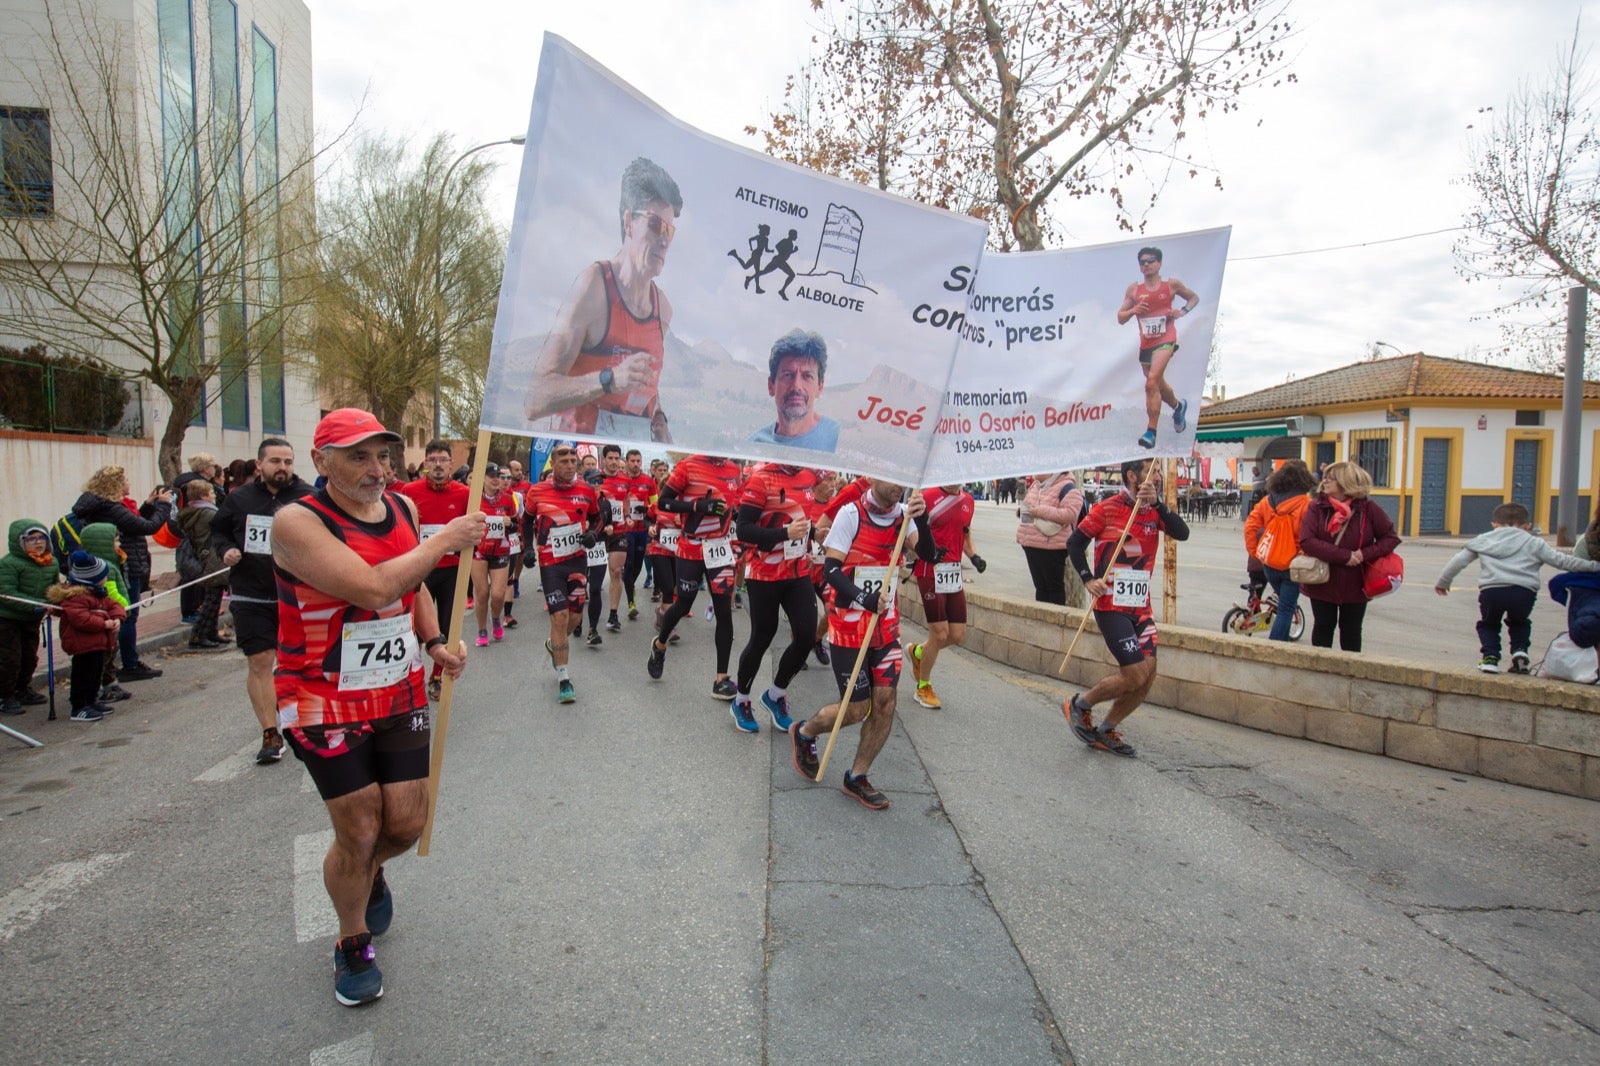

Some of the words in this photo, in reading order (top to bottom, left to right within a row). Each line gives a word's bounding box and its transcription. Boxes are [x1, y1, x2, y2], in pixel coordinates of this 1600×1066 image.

[735, 186, 808, 219] ATLETISMO
[796, 286, 865, 312] ALBOLOTE
[970, 286, 1054, 313] orrerás
[953, 390, 1028, 407] memoriam
[857, 396, 927, 431] José
[979, 410, 1036, 433] Osorio
[1044, 401, 1112, 428] Bolívar
[955, 437, 1015, 453] 1964-2023
[708, 546, 727, 559] 110
[936, 572, 961, 585] 3117
[863, 579, 891, 596] 82
[1116, 581, 1148, 596] 3100
[357, 637, 406, 667] 743
